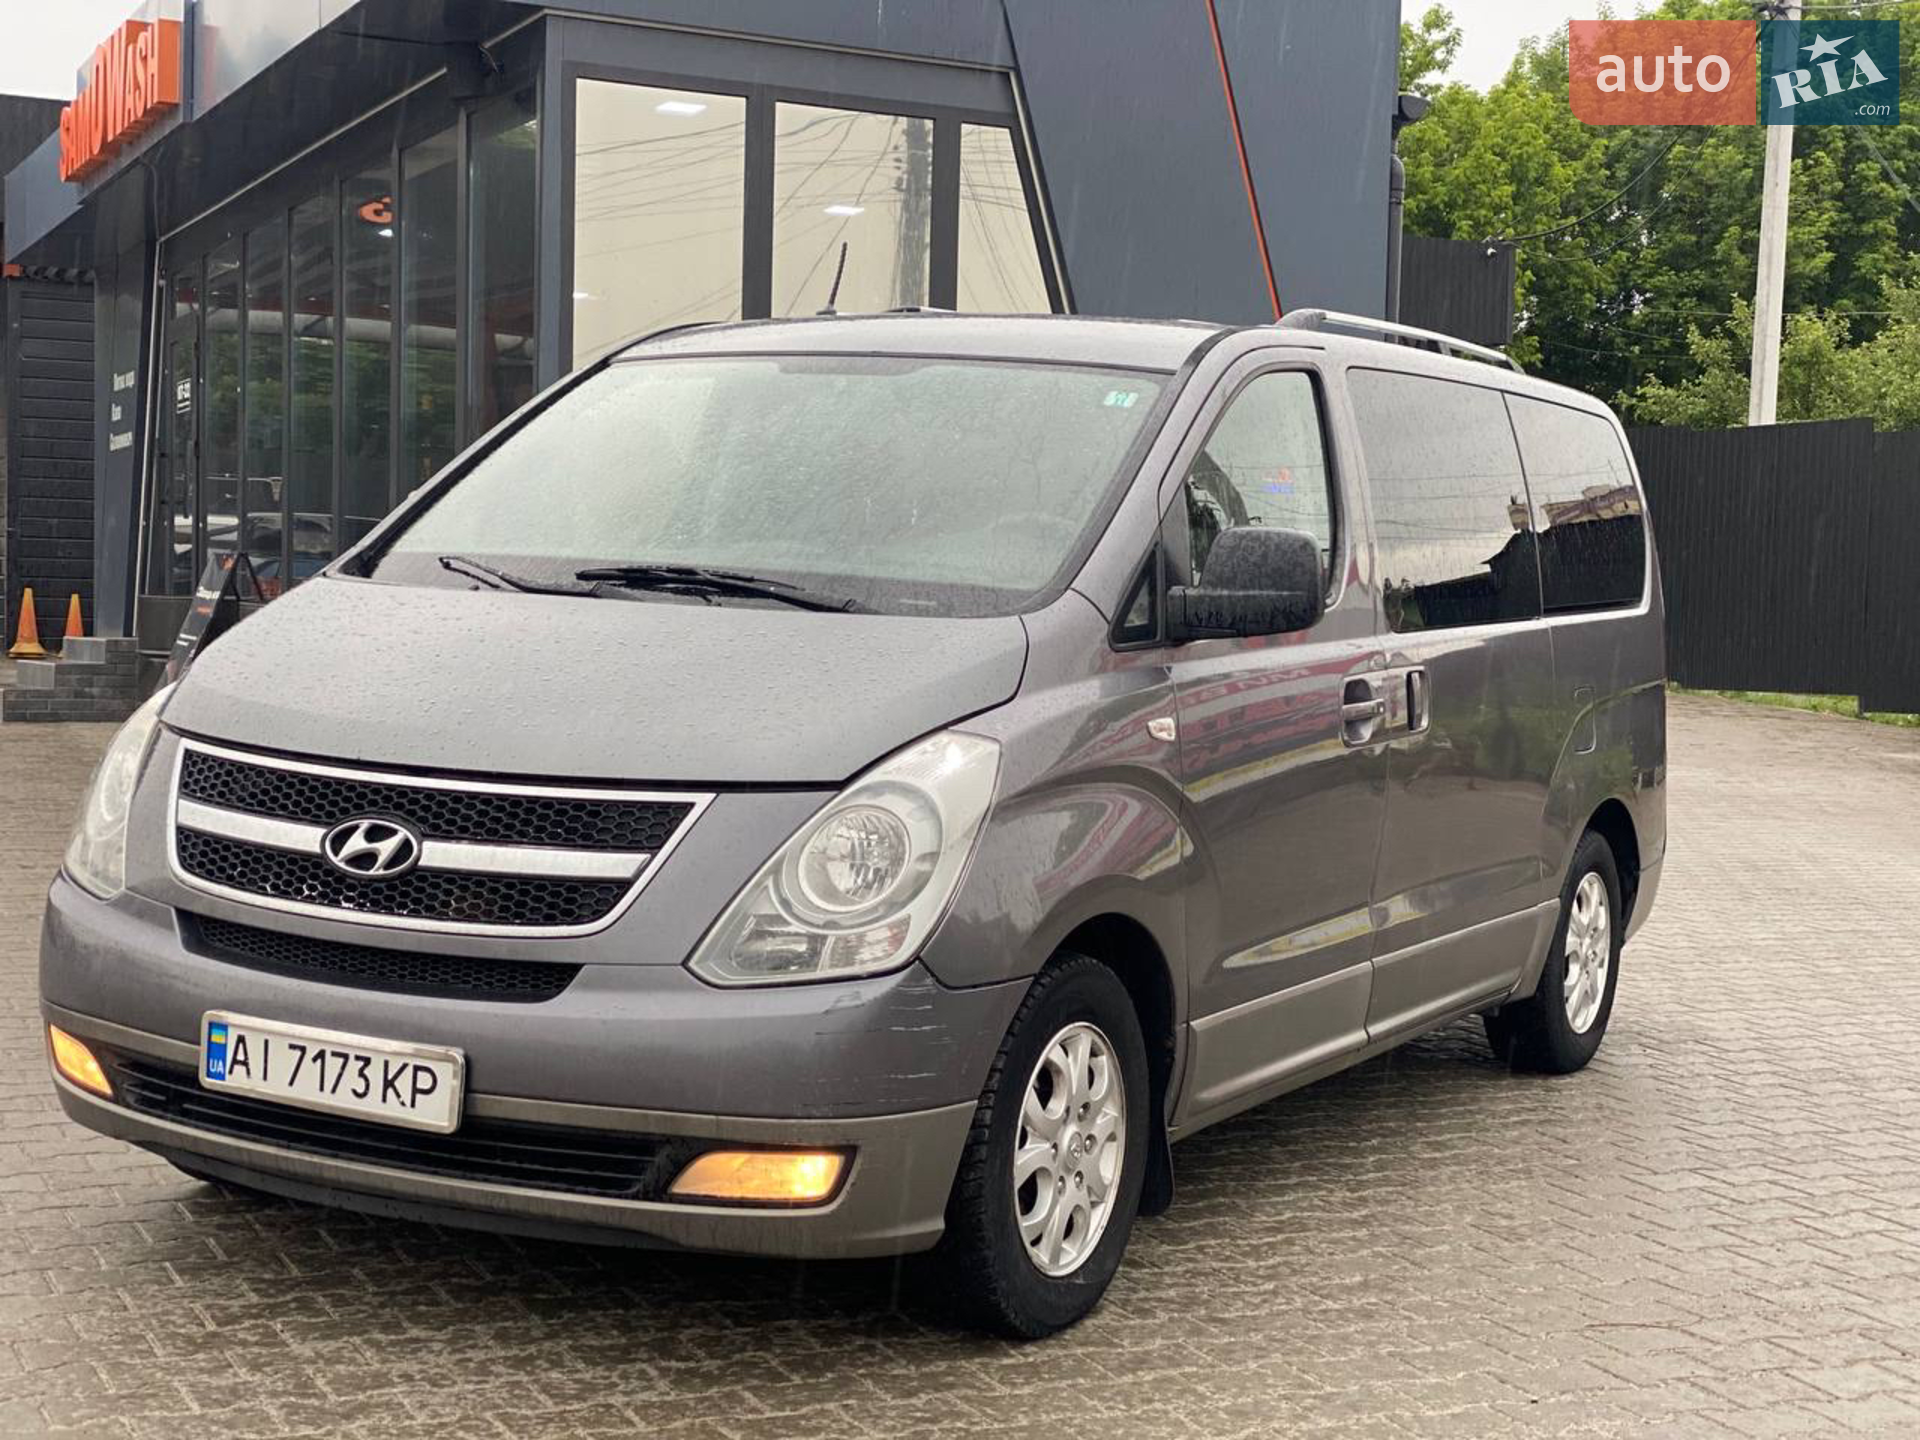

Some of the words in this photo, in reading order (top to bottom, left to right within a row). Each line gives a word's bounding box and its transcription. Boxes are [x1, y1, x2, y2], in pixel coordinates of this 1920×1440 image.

[209, 1060, 225, 1074] UA
[228, 1034, 270, 1082] AI
[287, 1043, 372, 1099] 7173
[381, 1060, 438, 1108] KP
